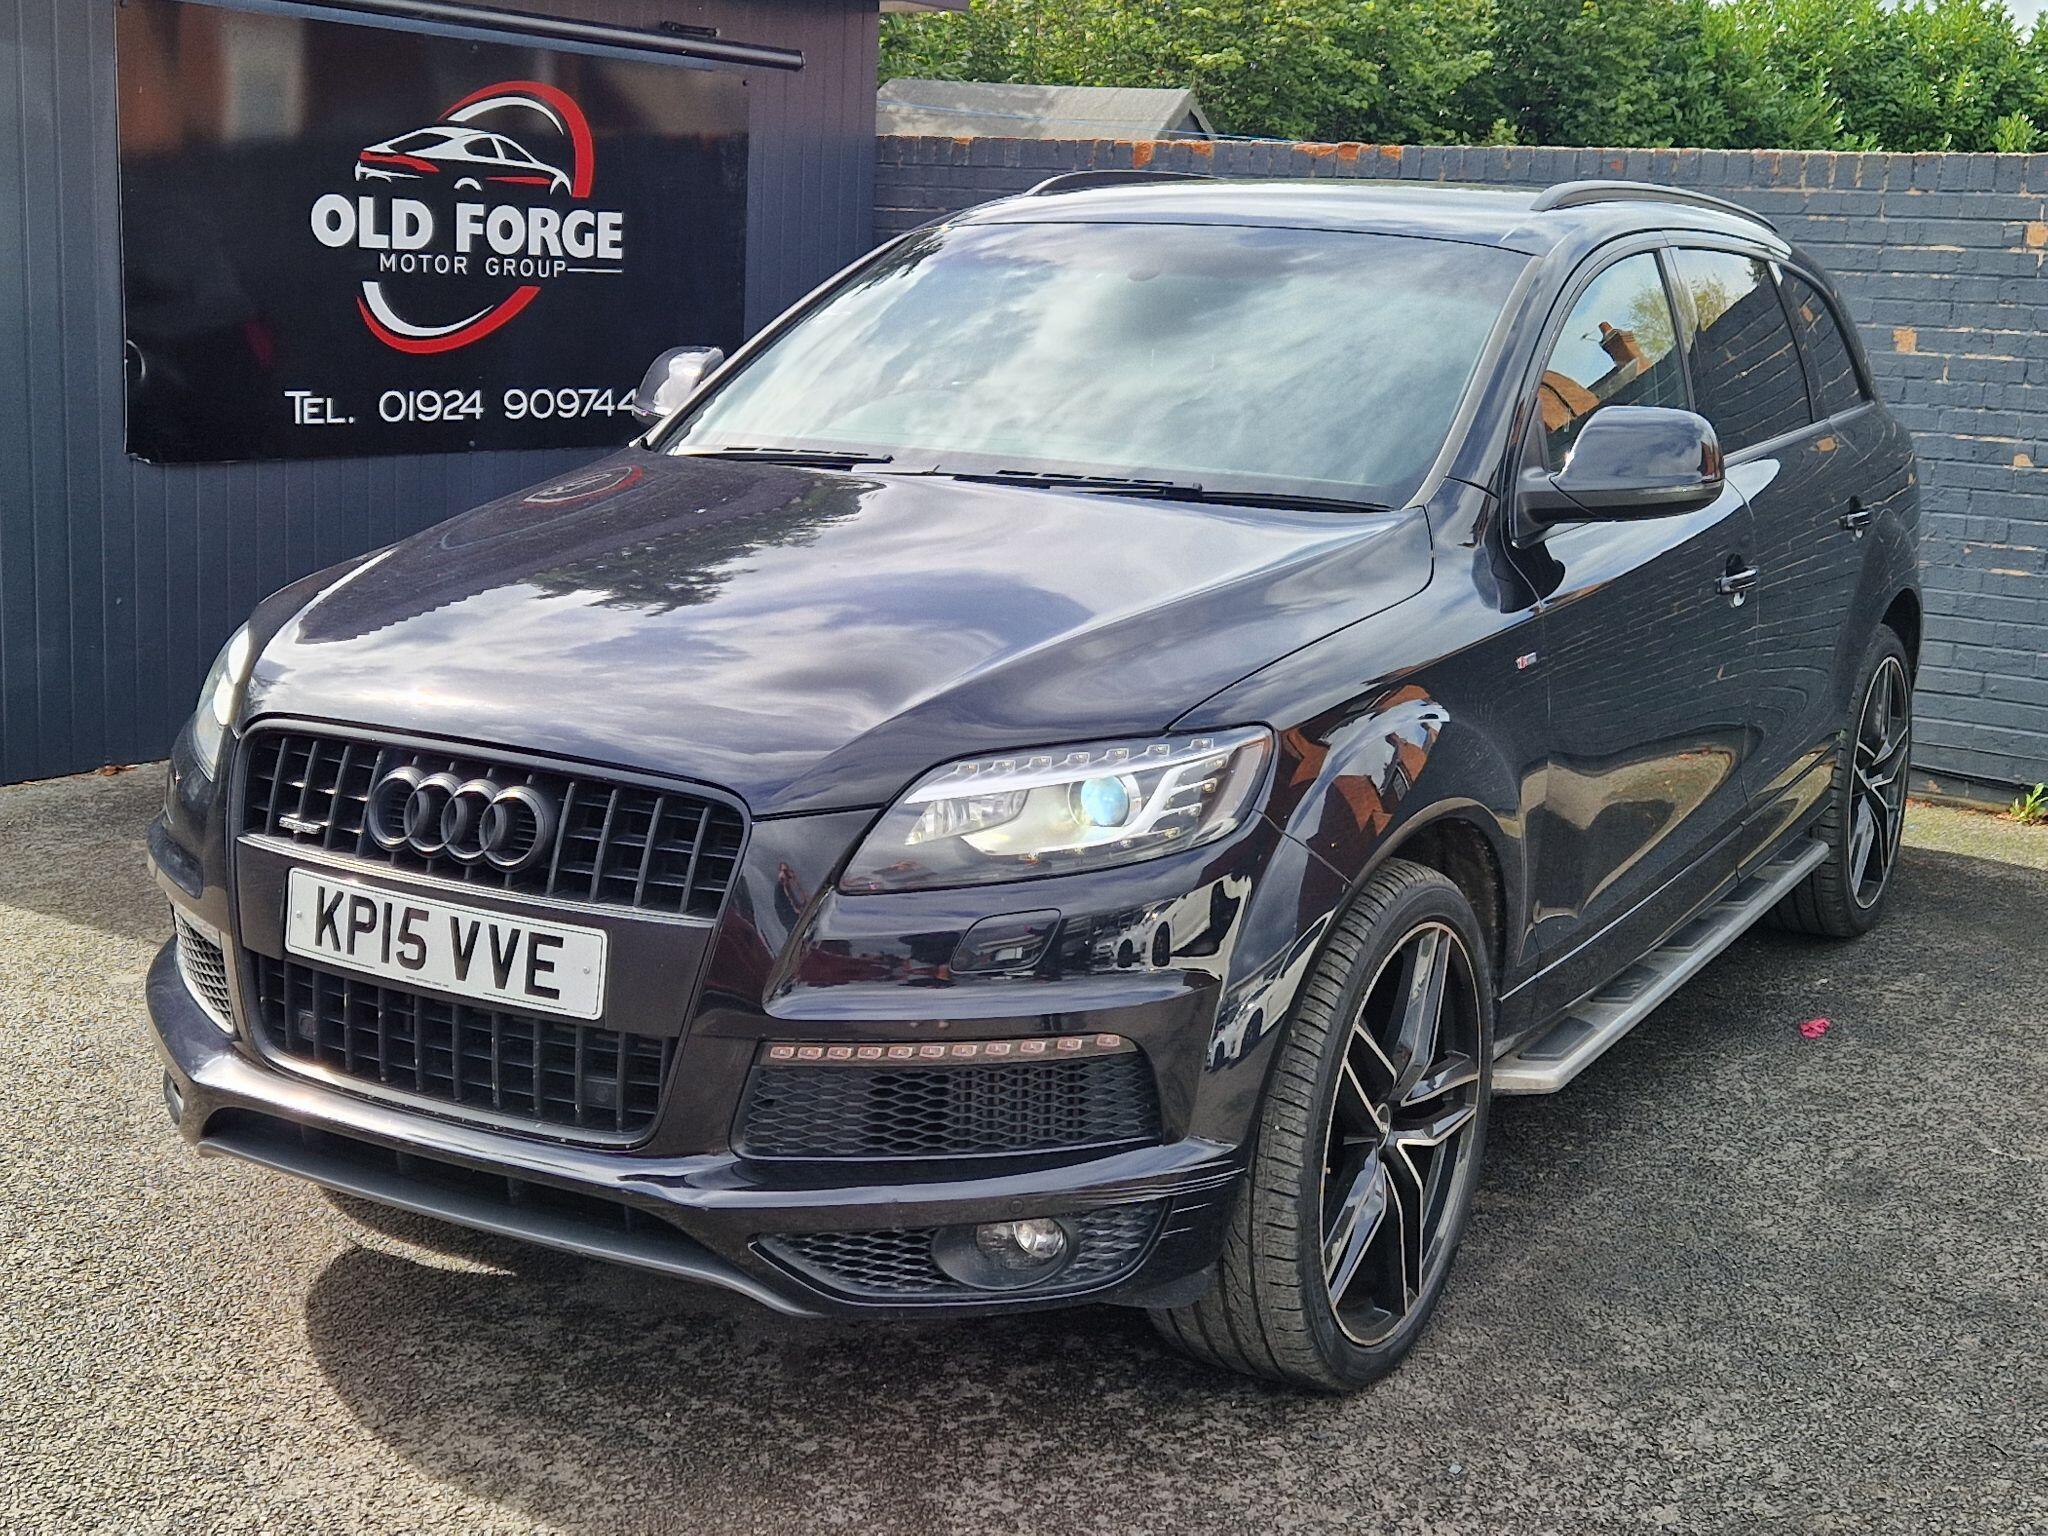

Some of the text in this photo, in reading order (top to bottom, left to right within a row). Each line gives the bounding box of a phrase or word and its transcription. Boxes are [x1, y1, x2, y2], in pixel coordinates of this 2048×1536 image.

[310, 193, 623, 260] OLD FORGE
[379, 253, 566, 278] MOTOR GROUP
[284, 387, 636, 424] TEL. 01924 909744
[314, 885, 564, 1001] KP15 VVE
